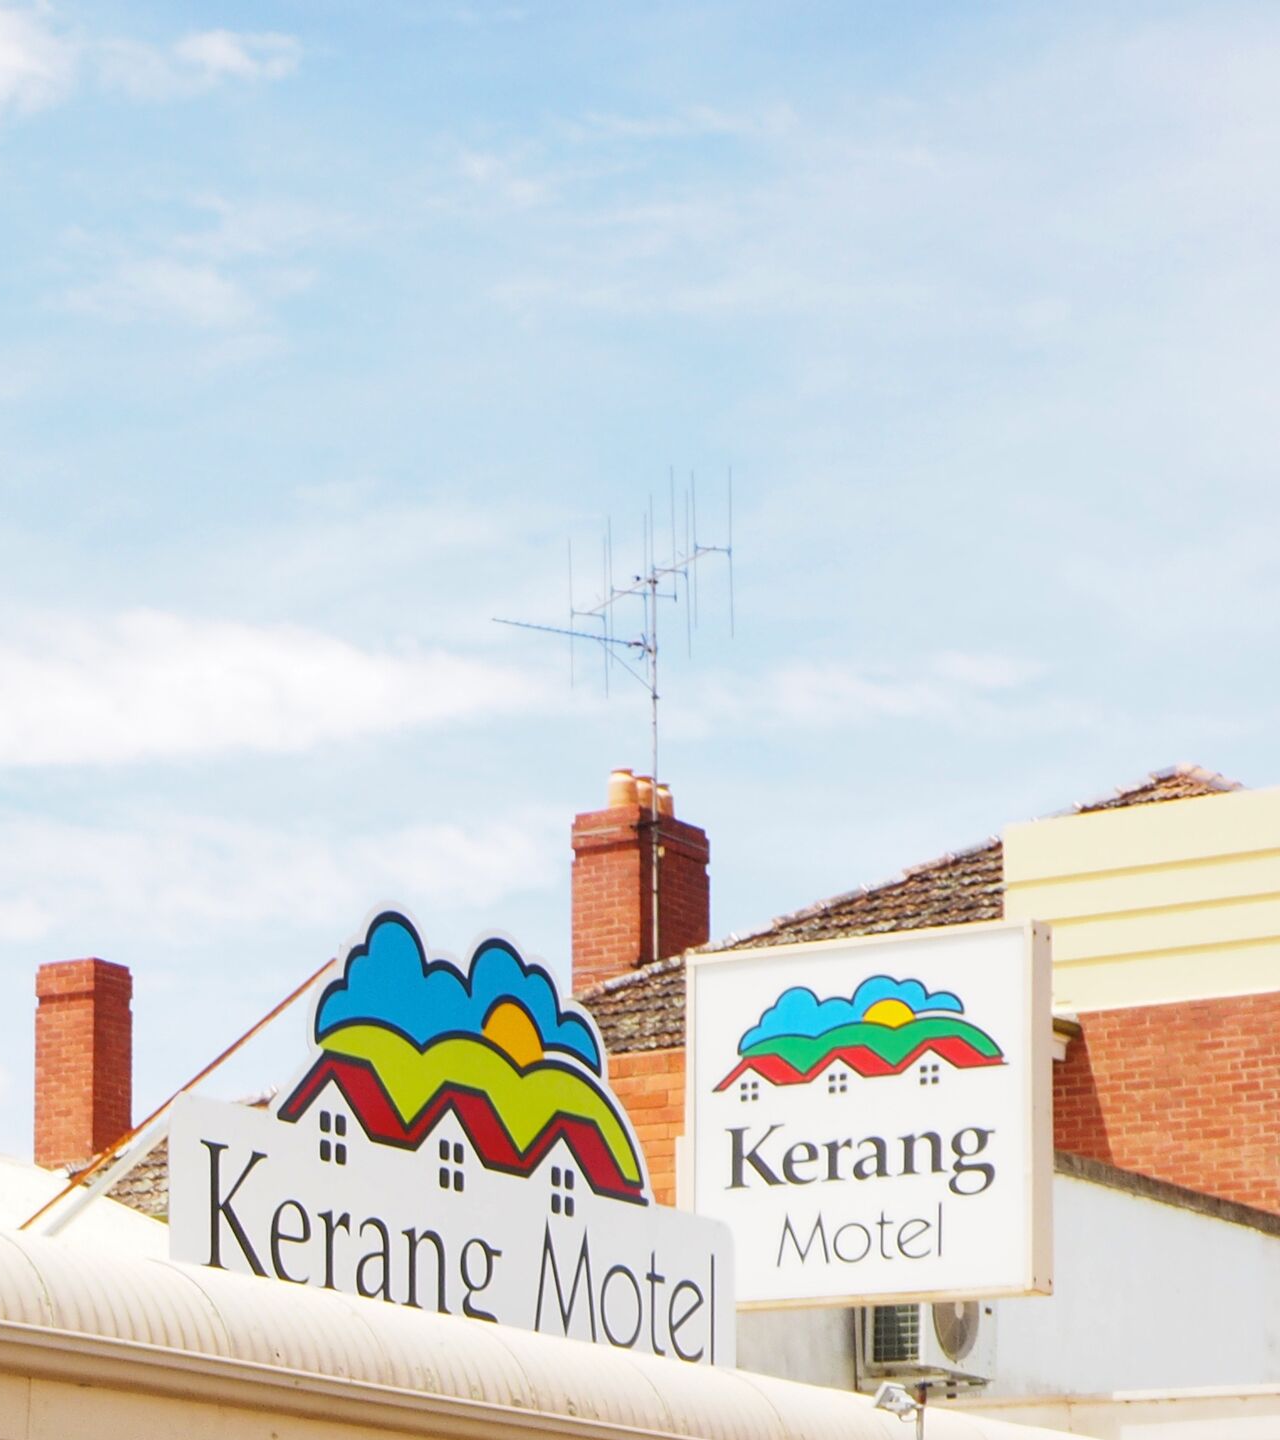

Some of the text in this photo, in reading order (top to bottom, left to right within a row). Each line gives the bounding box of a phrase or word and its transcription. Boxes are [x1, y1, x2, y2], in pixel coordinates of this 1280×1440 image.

[725, 1124, 996, 1195] Kerang
[200, 1139, 716, 1365] Kerang Motel
[777, 1201, 941, 1267] Motel
